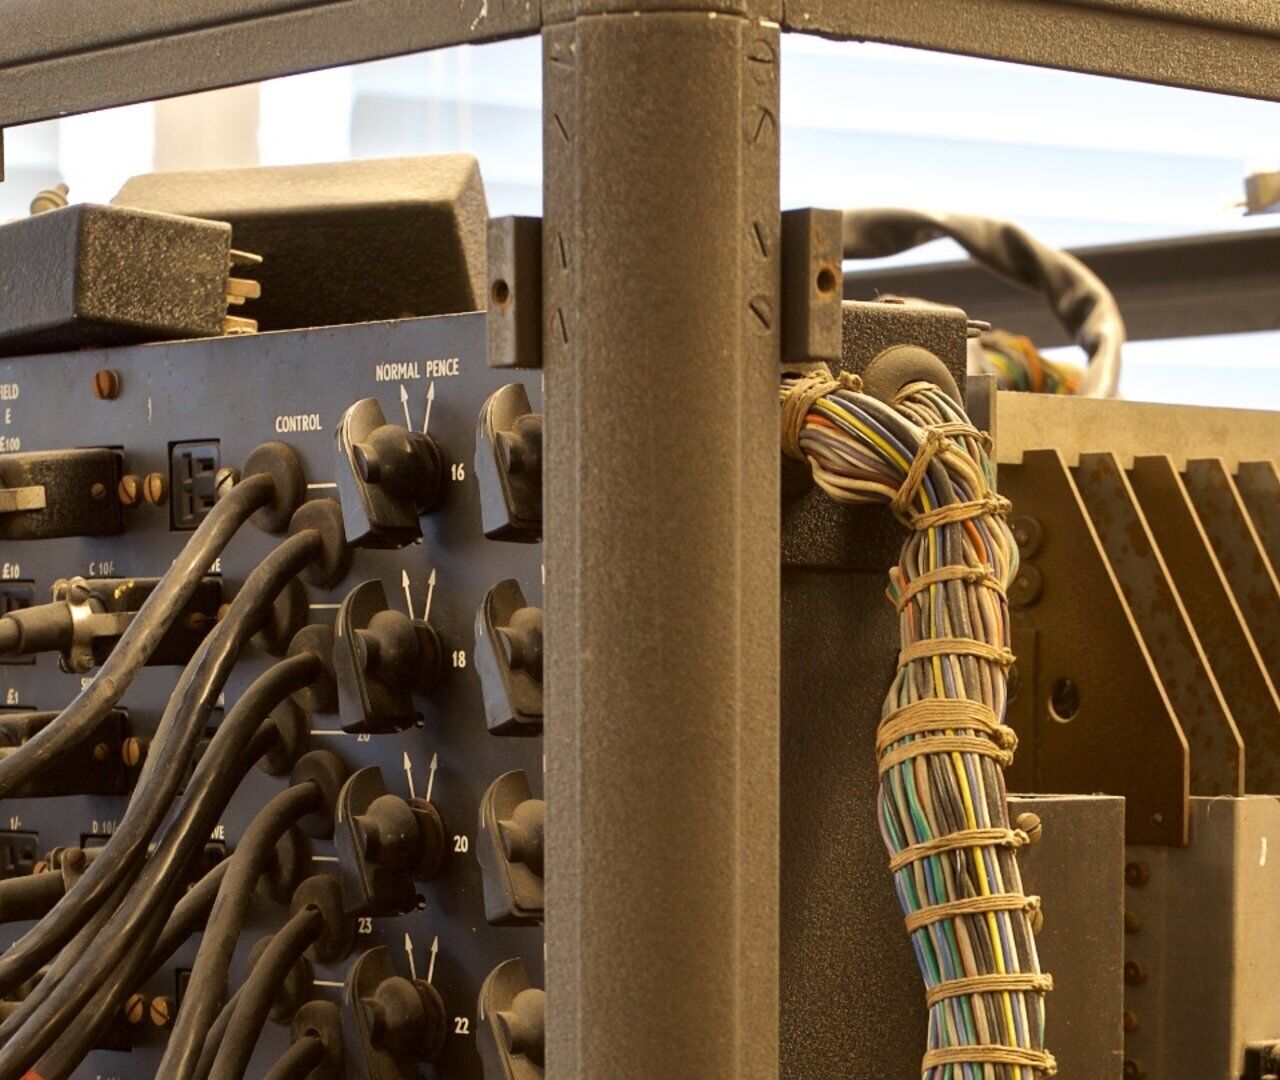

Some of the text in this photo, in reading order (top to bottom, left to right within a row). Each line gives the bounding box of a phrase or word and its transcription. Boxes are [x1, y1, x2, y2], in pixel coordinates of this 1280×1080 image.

[376, 358, 460, 381] NORMAL PENCE
[5, 408, 12, 424] E
[275, 413, 322, 433] CONTROL
[451, 463, 465, 481] 16
[2, 563, 20, 579] £10
[88, 562, 95, 576] C
[452, 650, 466, 668] 18
[92, 820, 99, 834] D
[453, 835, 469, 852] 20
[358, 917, 372, 933] 23
[454, 1017, 470, 1034] 22
